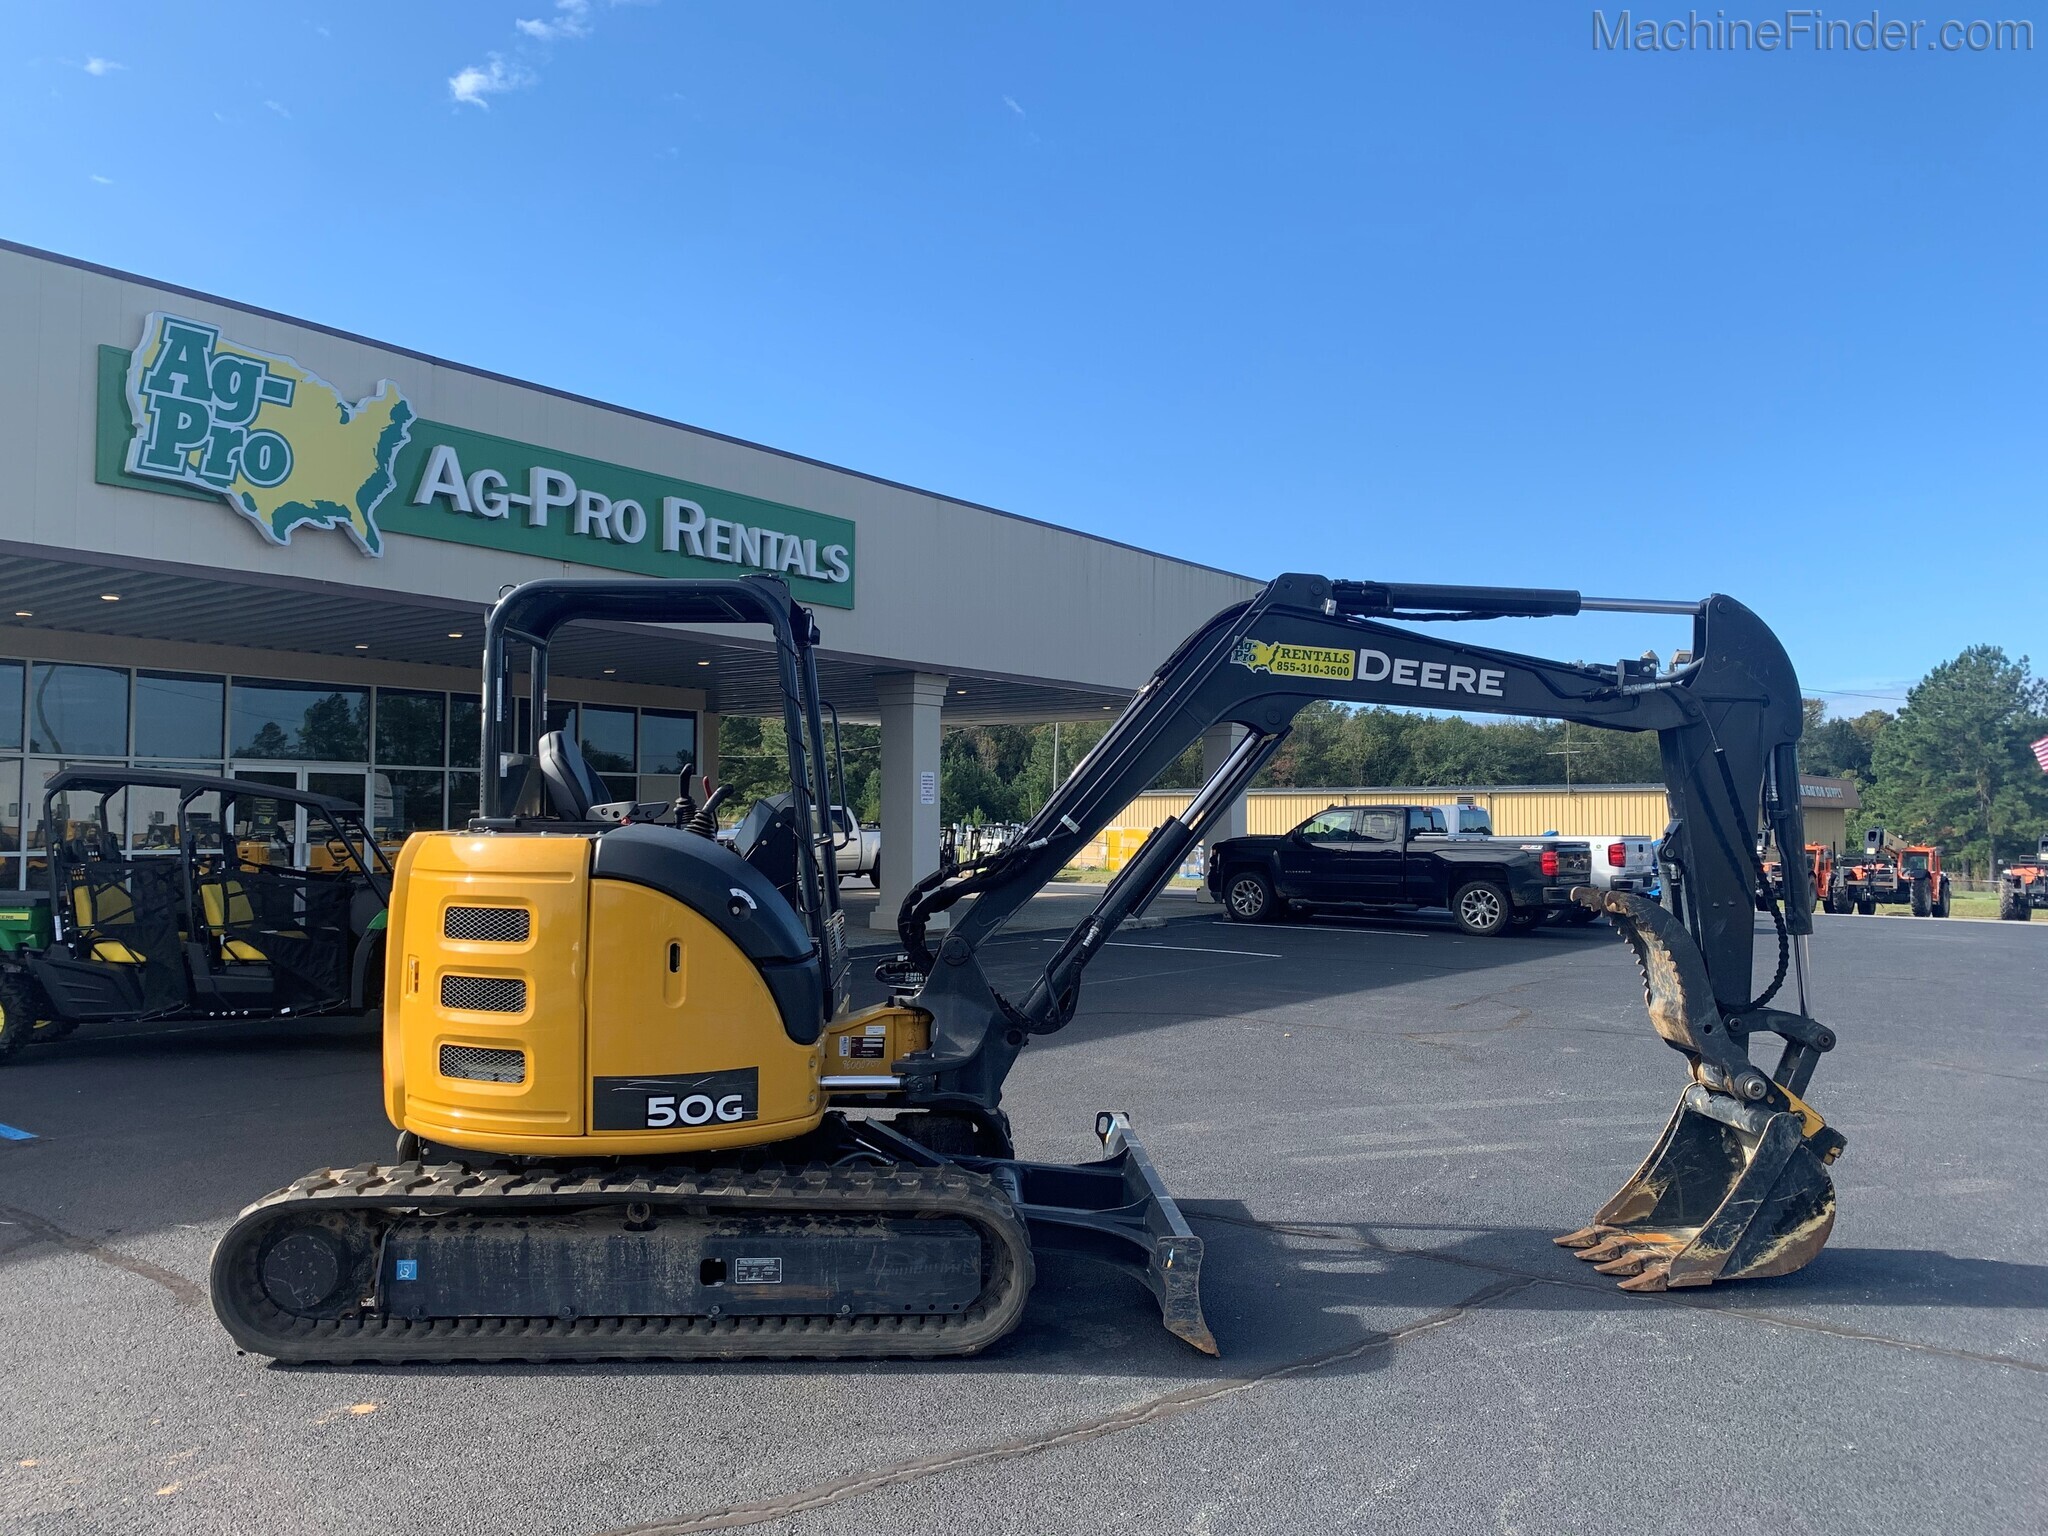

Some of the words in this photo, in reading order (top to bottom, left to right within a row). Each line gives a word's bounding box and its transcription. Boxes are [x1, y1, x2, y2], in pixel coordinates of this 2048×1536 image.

[144, 319, 295, 425] Ag-
[141, 395, 293, 486] Pro
[413, 444, 647, 544] AG-PRO
[662, 495, 850, 583] RENTALS
[1276, 661, 1350, 677] 855-310-3600
[1280, 649, 1351, 664] RENTALS
[1357, 648, 1505, 697] DEERE
[647, 1094, 743, 1127] 50G
